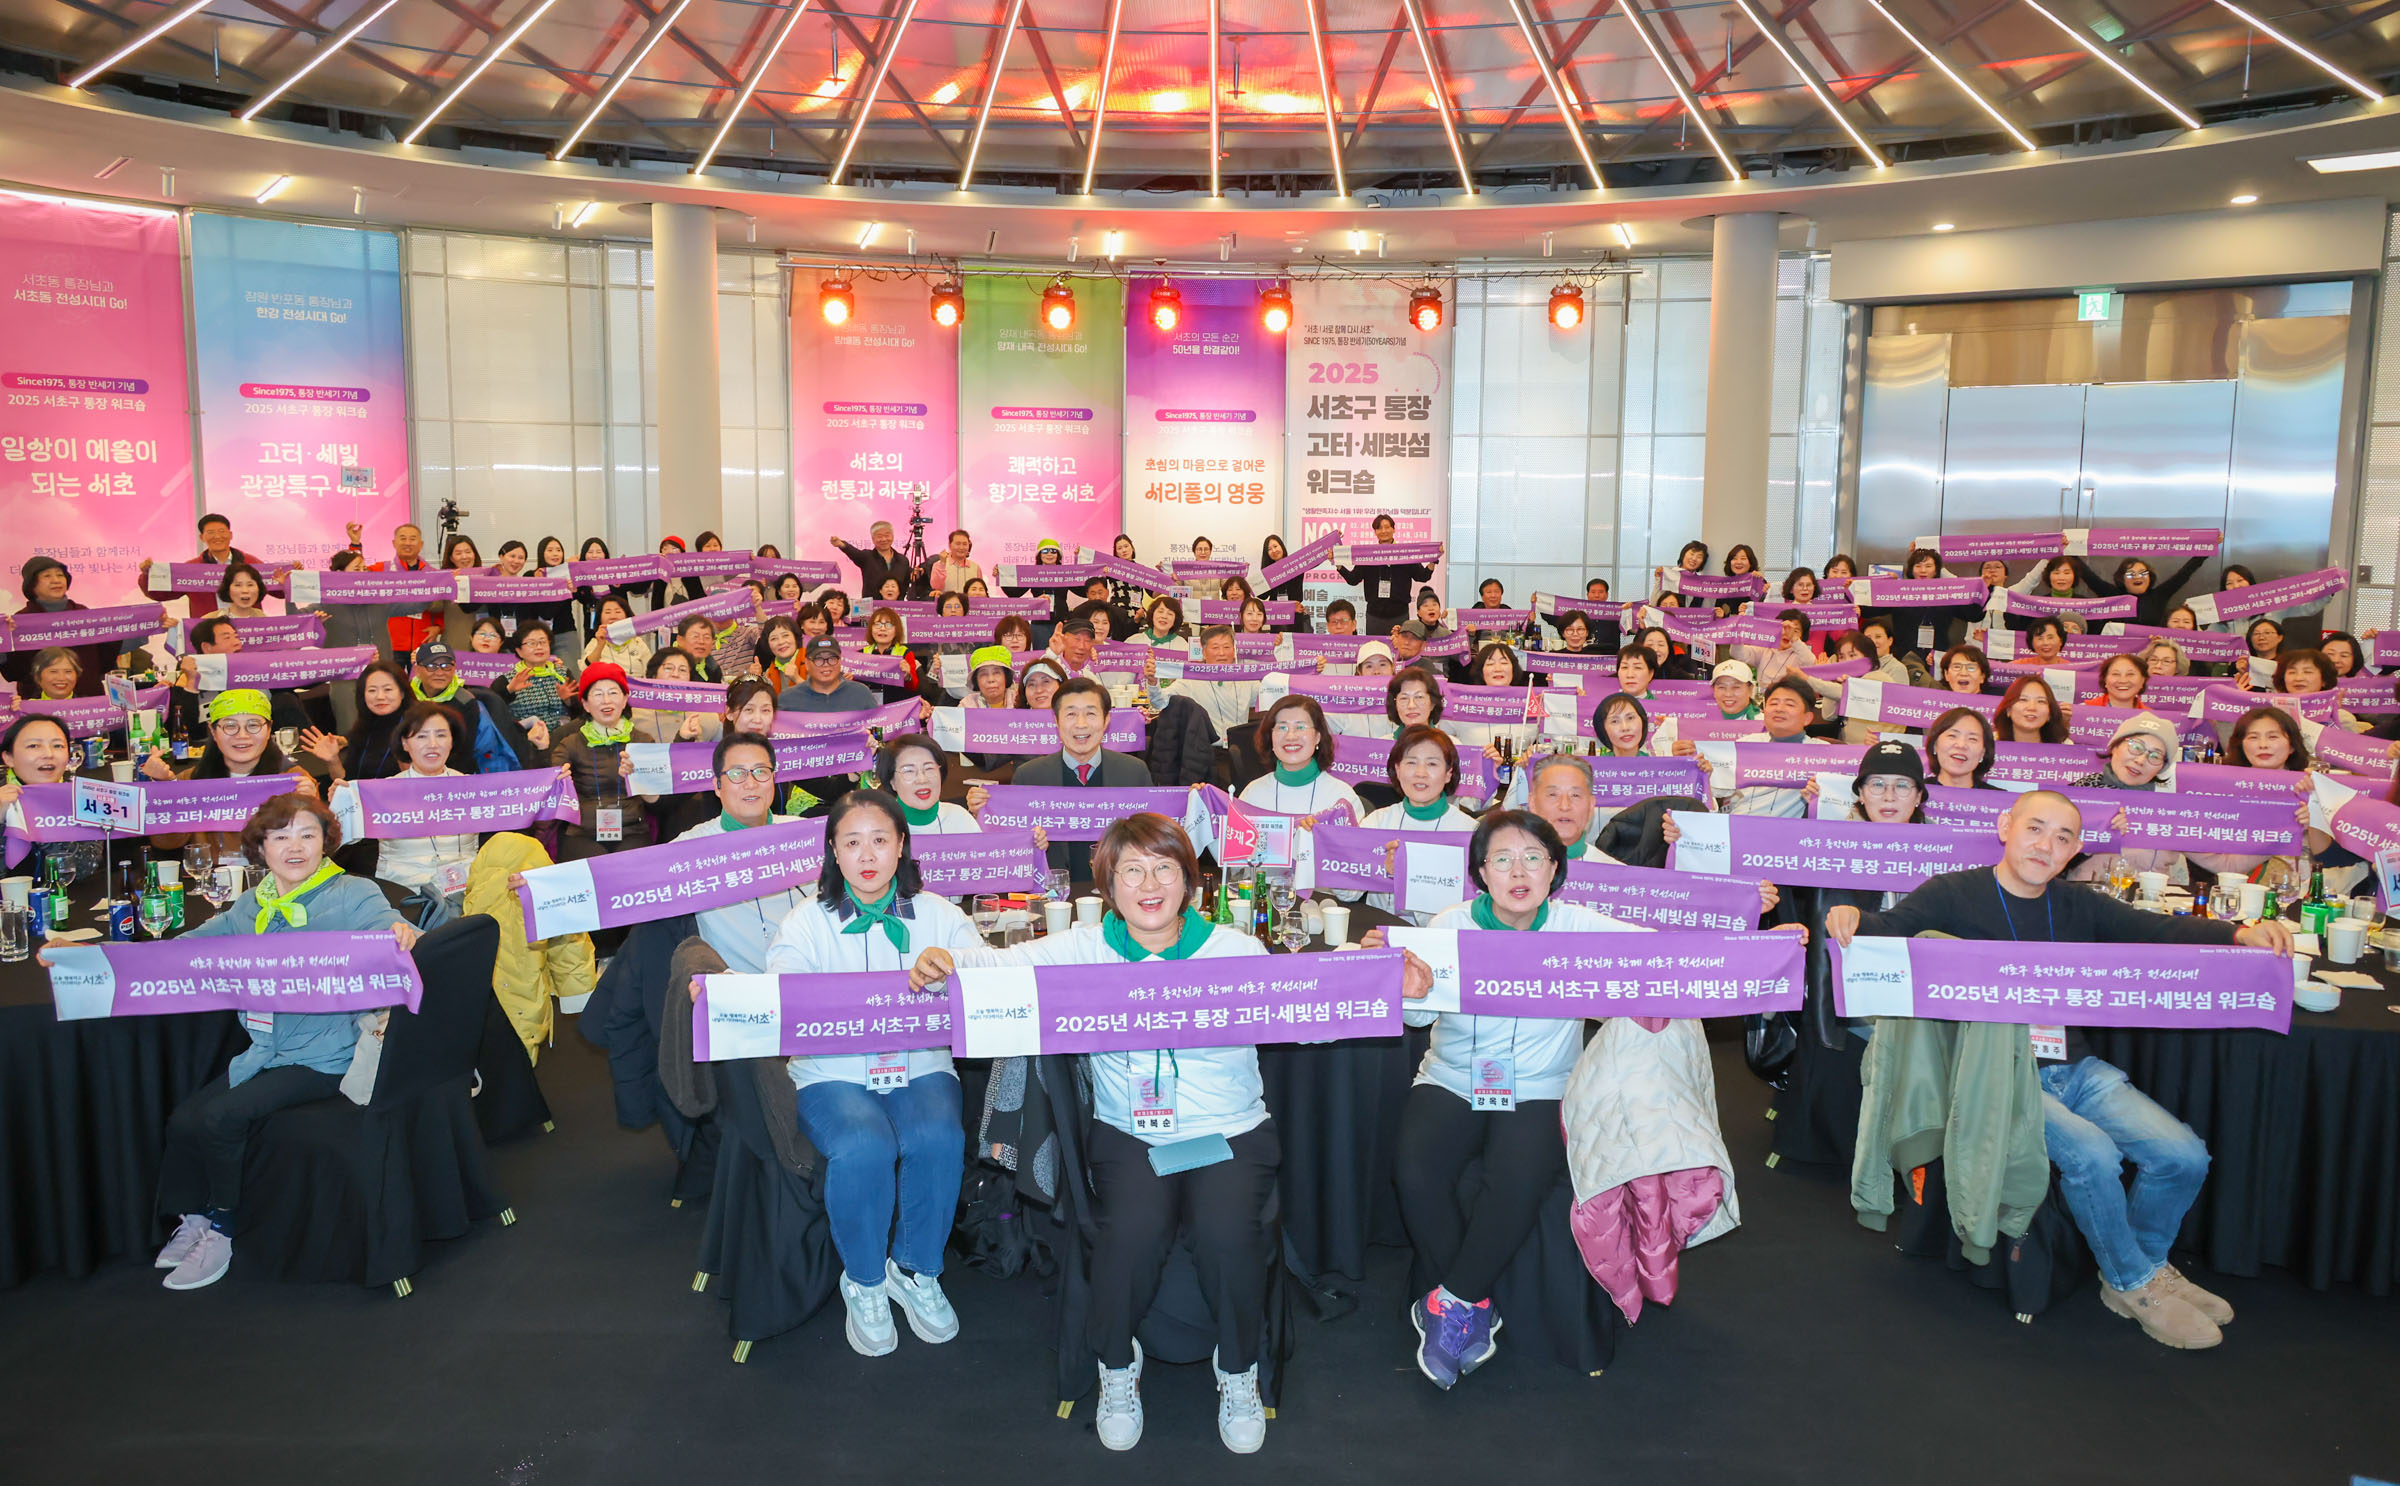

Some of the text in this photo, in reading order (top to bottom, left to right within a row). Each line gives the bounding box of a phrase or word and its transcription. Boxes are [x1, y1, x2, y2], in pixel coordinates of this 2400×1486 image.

[14, 289, 128, 310] 서초동 전성시대 Go!
[256, 307, 347, 324] 한강 전성시대 Go!
[1174, 332, 1239, 343] 서초의 모든 순간
[1304, 336, 1320, 345] SINCE
[1321, 337, 1336, 346] 1975,
[1074, 343, 1088, 354] Go!
[1173, 345, 1240, 355] 50년을 한결같이!
[17, 376, 66, 388] Since1975,
[1308, 362, 1379, 384] 2025
[8, 394, 147, 412] 2025 서초구 통장 워크숍
[245, 403, 368, 419] 2025 서초구 통장 워크숍
[1307, 395, 1432, 420] 서초구 통장
[826, 419, 849, 428] 2025
[851, 419, 877, 429] 서초구
[994, 424, 1016, 432] 2025
[1, 436, 157, 463] 일상이 예술이
[1307, 432, 1430, 458] 고터·세빛섬
[850, 452, 903, 472] 서초의
[1145, 458, 1266, 473] 초심의 마음으로 걸어온
[31, 471, 136, 497] 되는 서초
[240, 474, 331, 498] 관광특구
[821, 480, 875, 500] 전통과
[1307, 469, 1375, 494] 워크숍
[988, 482, 1096, 503] 향기로운 서초
[1145, 482, 1266, 505] 서리풀의 영웅
[1303, 589, 1328, 602] 예술
[84, 798, 128, 819] 서 3-1
[371, 806, 495, 825] 2025년 서초구 통장
[984, 814, 1091, 829] 2025년 서초구 통장
[2146, 824, 2173, 838] 통장
[2251, 830, 2293, 844] 워크숍
[1742, 853, 1799, 871] 2025년
[1802, 855, 1846, 874] 서초구
[1850, 858, 1879, 876] 통장
[920, 866, 982, 885] 서초구 통장
[610, 884, 674, 911] 2025년
[677, 875, 722, 901] 서초구
[725, 870, 754, 895] 통장
[1701, 912, 1748, 931] 워크숍
[129, 977, 196, 997] 2025년
[200, 977, 244, 996] 서초구
[247, 978, 277, 997] 통장
[1474, 976, 1791, 1000] 2025년 서초구 통장 고터·세빛섬 워크숍
[1927, 983, 2277, 1012] 2025년 서초구 통장 고터·세빛섬 워크숍
[1005, 1005, 1029, 1019] 서초
[1055, 997, 1390, 1035] 2025년 서초구 통장 고터·세빛섬 워크숍
[795, 1014, 921, 1038] 2025년 서초구
